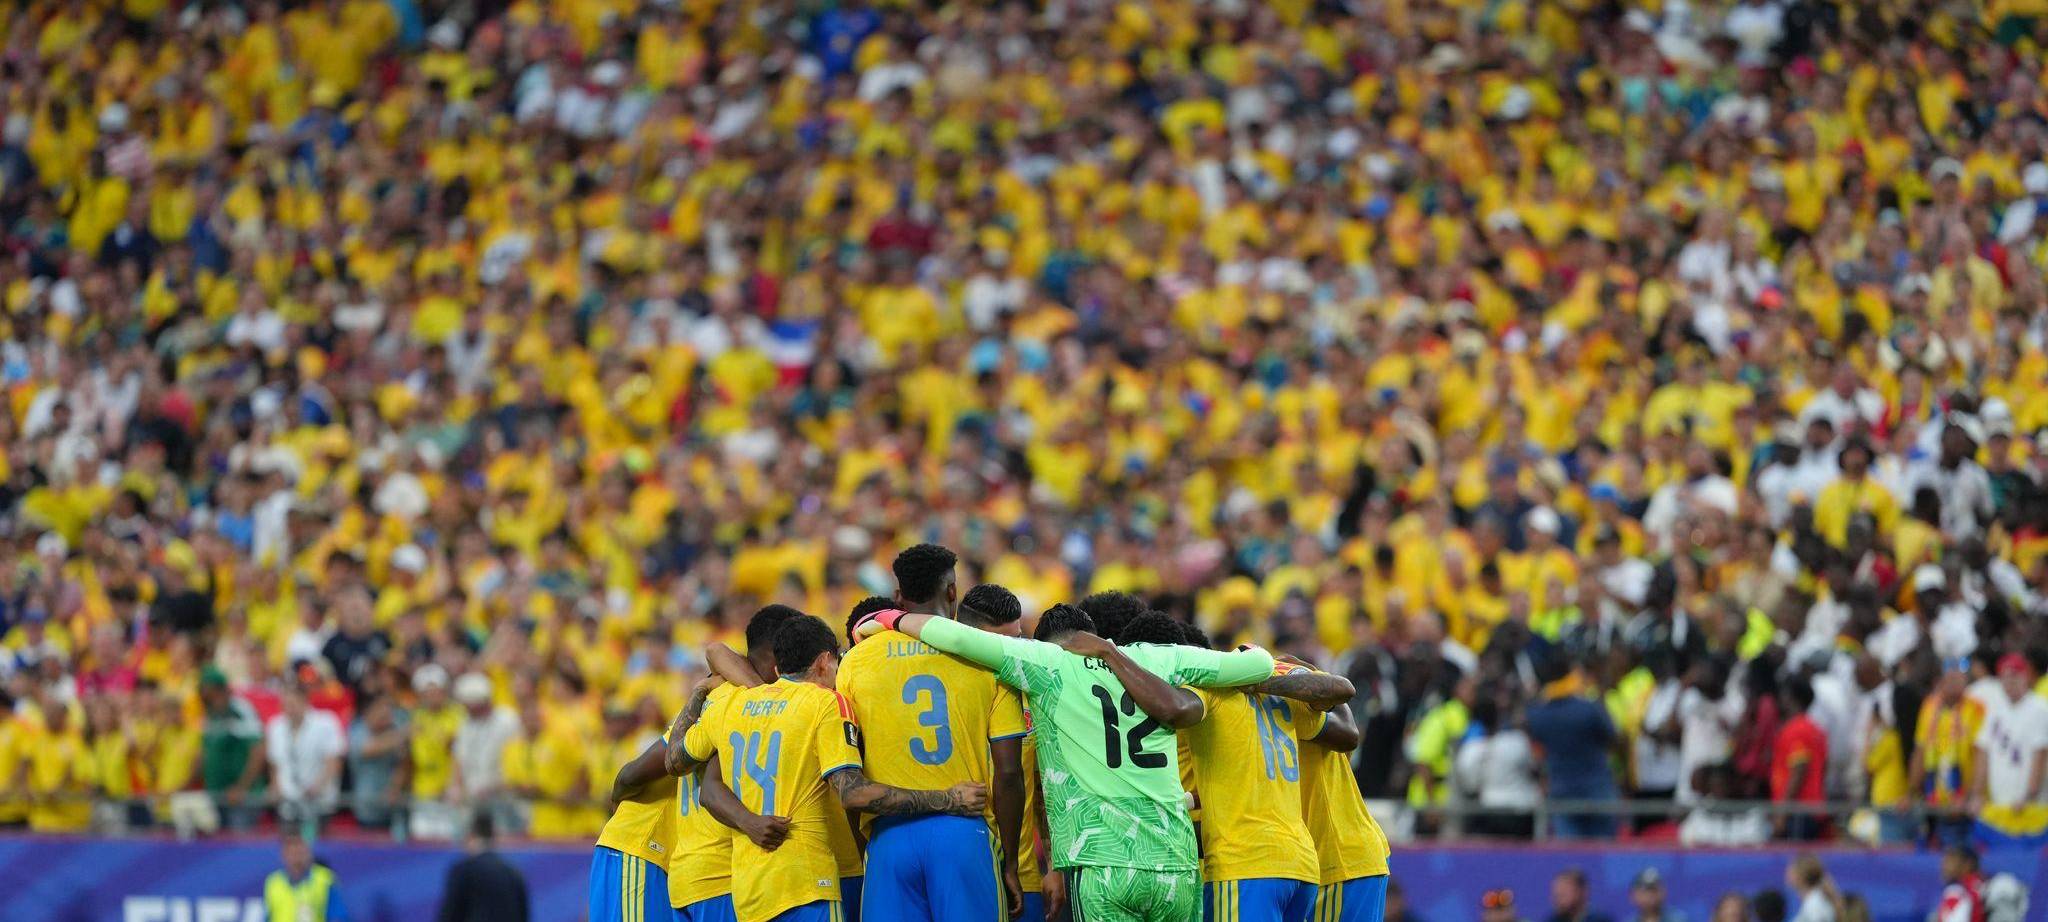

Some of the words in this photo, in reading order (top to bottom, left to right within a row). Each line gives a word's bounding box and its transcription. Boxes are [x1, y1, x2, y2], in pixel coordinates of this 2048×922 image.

[901, 673, 953, 766] 3
[1091, 684, 1168, 769] 12
[1247, 693, 1299, 782] 16
[729, 730, 782, 816] 14
